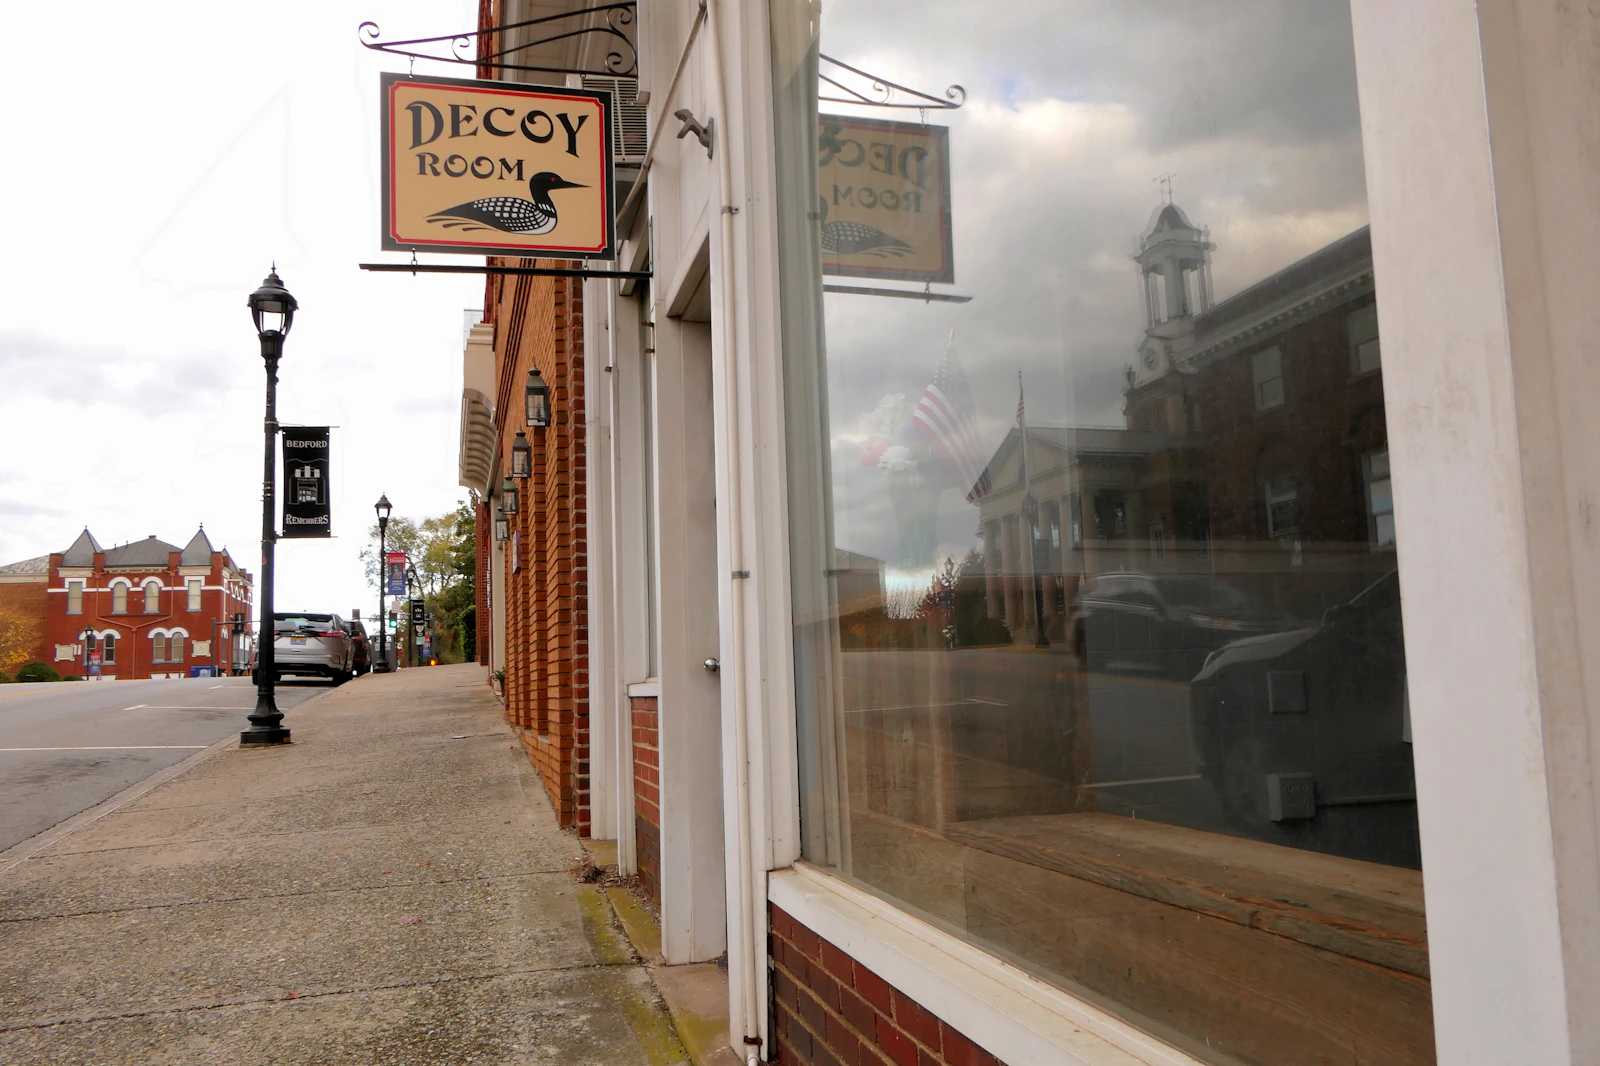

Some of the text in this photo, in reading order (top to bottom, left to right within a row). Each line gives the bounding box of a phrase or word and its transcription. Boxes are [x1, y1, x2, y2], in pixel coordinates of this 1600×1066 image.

[405, 100, 589, 158] DECOY
[415, 152, 525, 181] ROOM
[286, 440, 328, 448] BEDFORD
